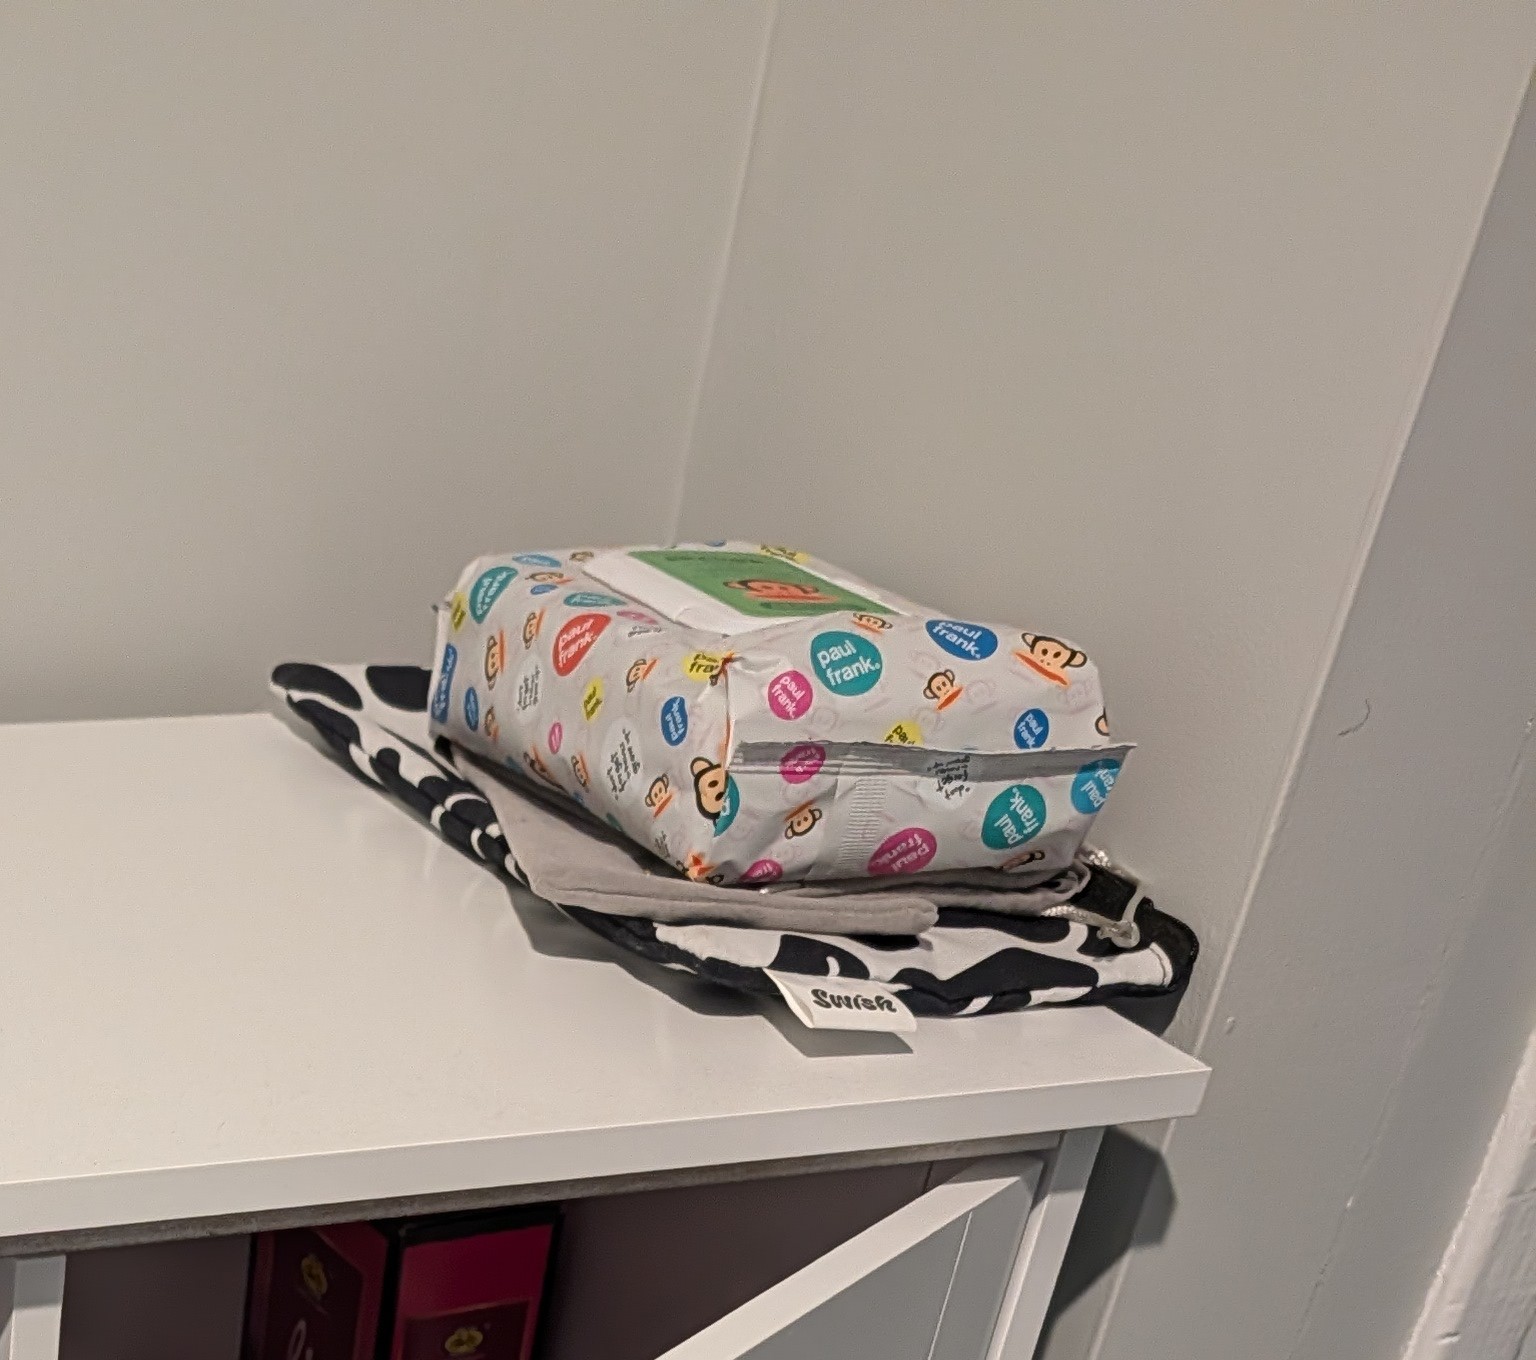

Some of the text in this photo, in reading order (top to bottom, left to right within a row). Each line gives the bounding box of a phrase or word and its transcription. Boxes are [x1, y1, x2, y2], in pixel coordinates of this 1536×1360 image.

[932, 626, 982, 659] frank.
[938, 621, 983, 640] paul
[816, 639, 857, 668] paul
[825, 655, 881, 687] frank.
[779, 675, 806, 699] paul
[1025, 712, 1045, 736] paul
[1009, 787, 1040, 835] frank.
[994, 813, 1026, 845] paul
[891, 845, 930, 873] paul
[811, 988, 897, 1014] Swish
